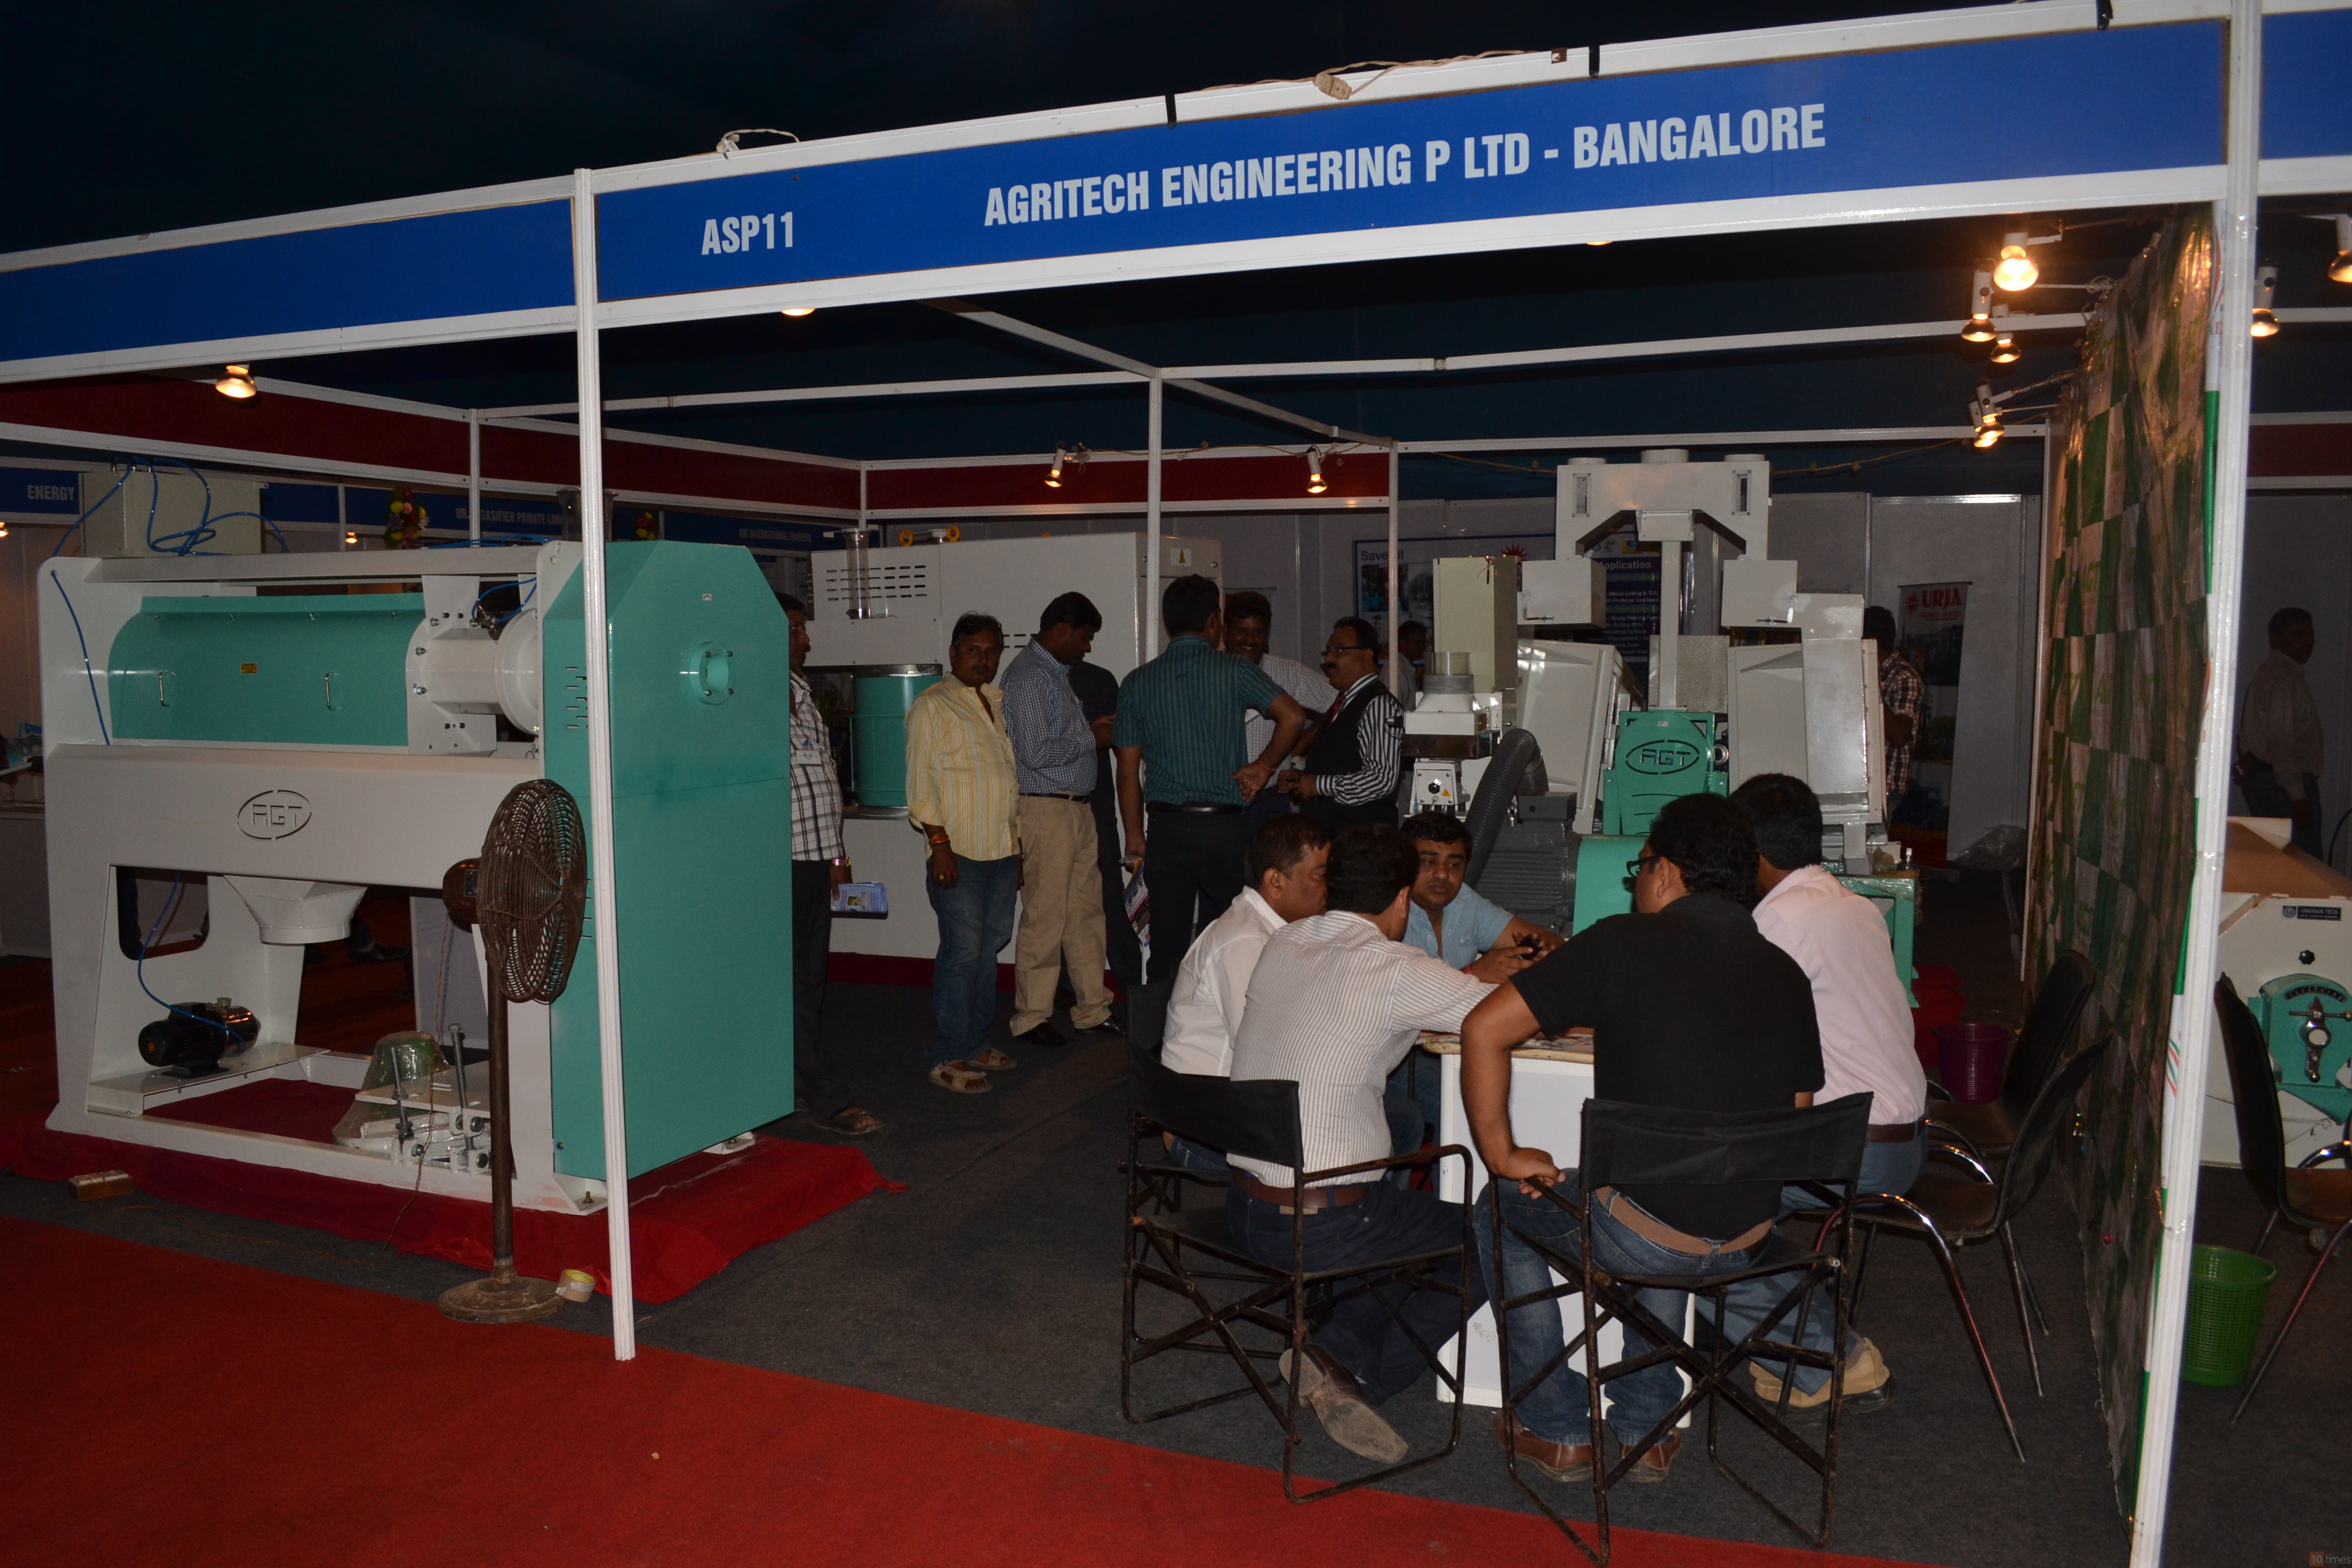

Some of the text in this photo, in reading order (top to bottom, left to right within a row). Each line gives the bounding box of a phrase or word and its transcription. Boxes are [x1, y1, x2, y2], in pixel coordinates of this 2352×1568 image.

[985, 103, 1825, 226] AGRITECH ENGINEERING P LTD - BANGALORE
[702, 212, 793, 255] ASP11
[27, 484, 75, 501] ENERGY
[517, 511, 546, 525] PRIVATE
[1361, 550, 1388, 560] Save
[1922, 588, 1962, 610] URJA
[1640, 748, 1691, 767] AGT
[253, 804, 302, 827] AGT
